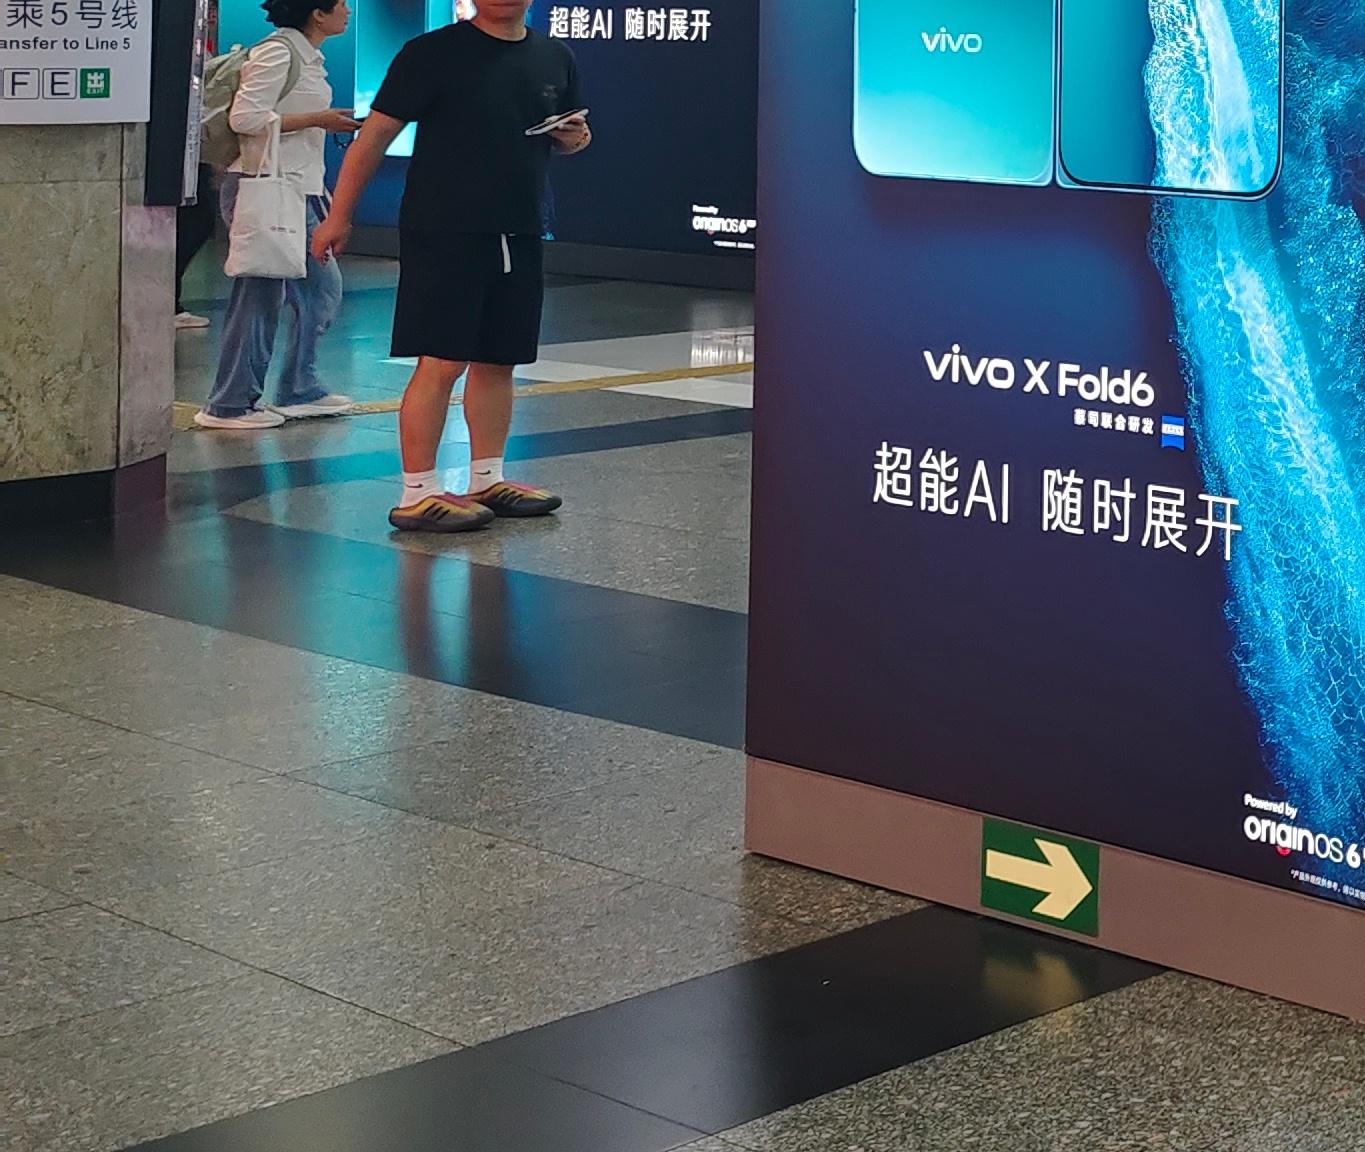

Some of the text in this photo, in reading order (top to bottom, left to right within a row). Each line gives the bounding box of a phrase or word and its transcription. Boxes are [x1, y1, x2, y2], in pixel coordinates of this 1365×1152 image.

[549, 6, 712, 42] 超能AI 随时展开
[63, 37, 80, 50] to
[85, 37, 118, 50] Line
[122, 37, 131, 49] 5
[921, 26, 983, 53] vivo
[11, 71, 70, 97] F E
[923, 343, 1155, 407] vivo X Fold6
[873, 441, 1242, 561] 超能AI 随时展开
[1244, 793, 1298, 820] Powered by
[1345, 843, 1361, 869] 6
